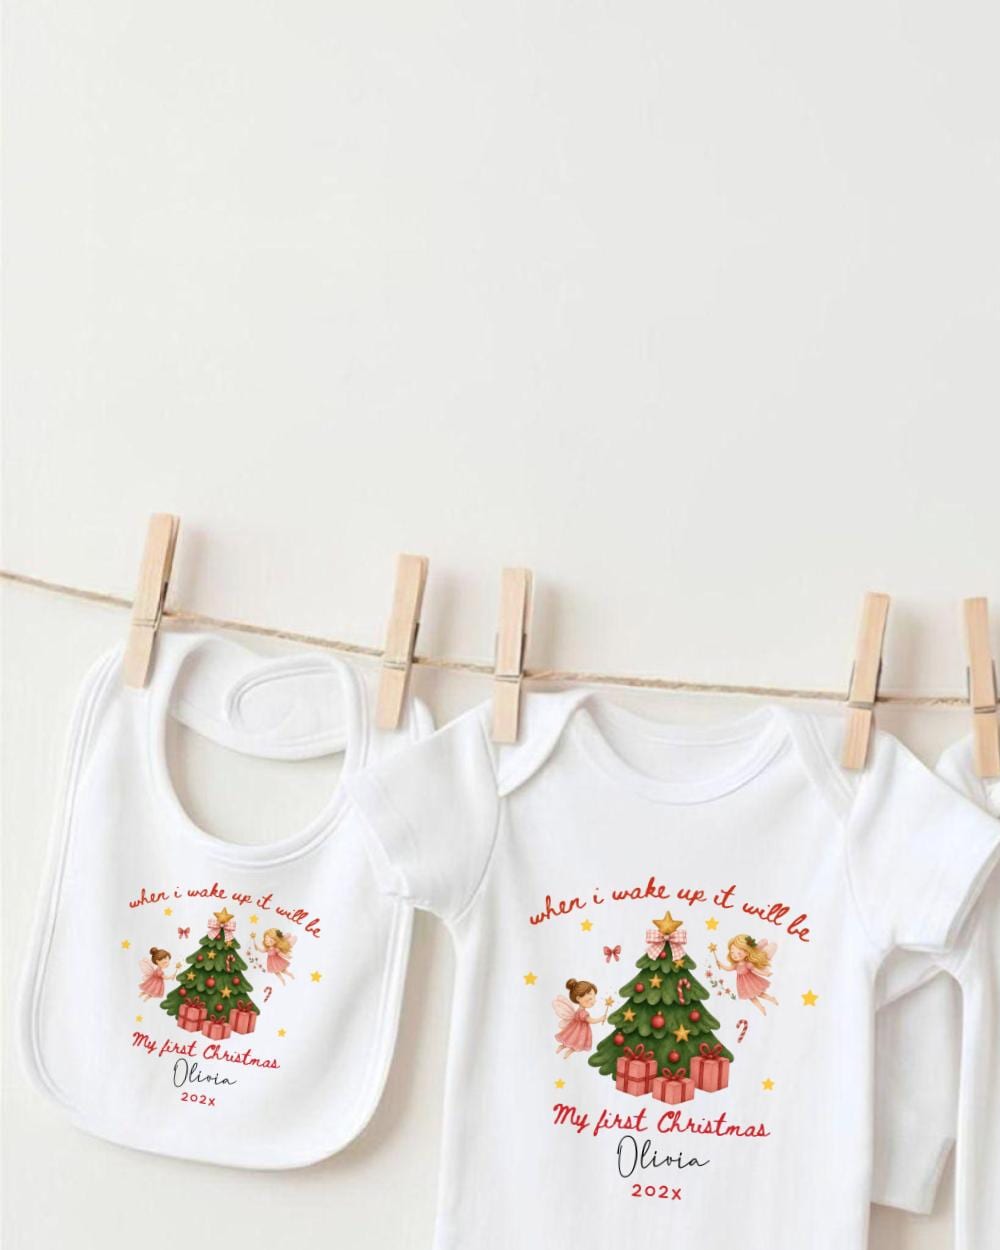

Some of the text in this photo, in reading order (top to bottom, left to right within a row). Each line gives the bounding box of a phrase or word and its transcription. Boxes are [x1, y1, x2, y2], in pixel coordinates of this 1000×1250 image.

[129, 883, 321, 939] when i wake up it will be
[529, 877, 811, 942] when i wake up it will be
[132, 1031, 281, 1069] My first Christmas
[173, 1058, 237, 1088] Olivia
[553, 1103, 771, 1138] My first Christmas
[616, 1135, 710, 1179] Olivia
